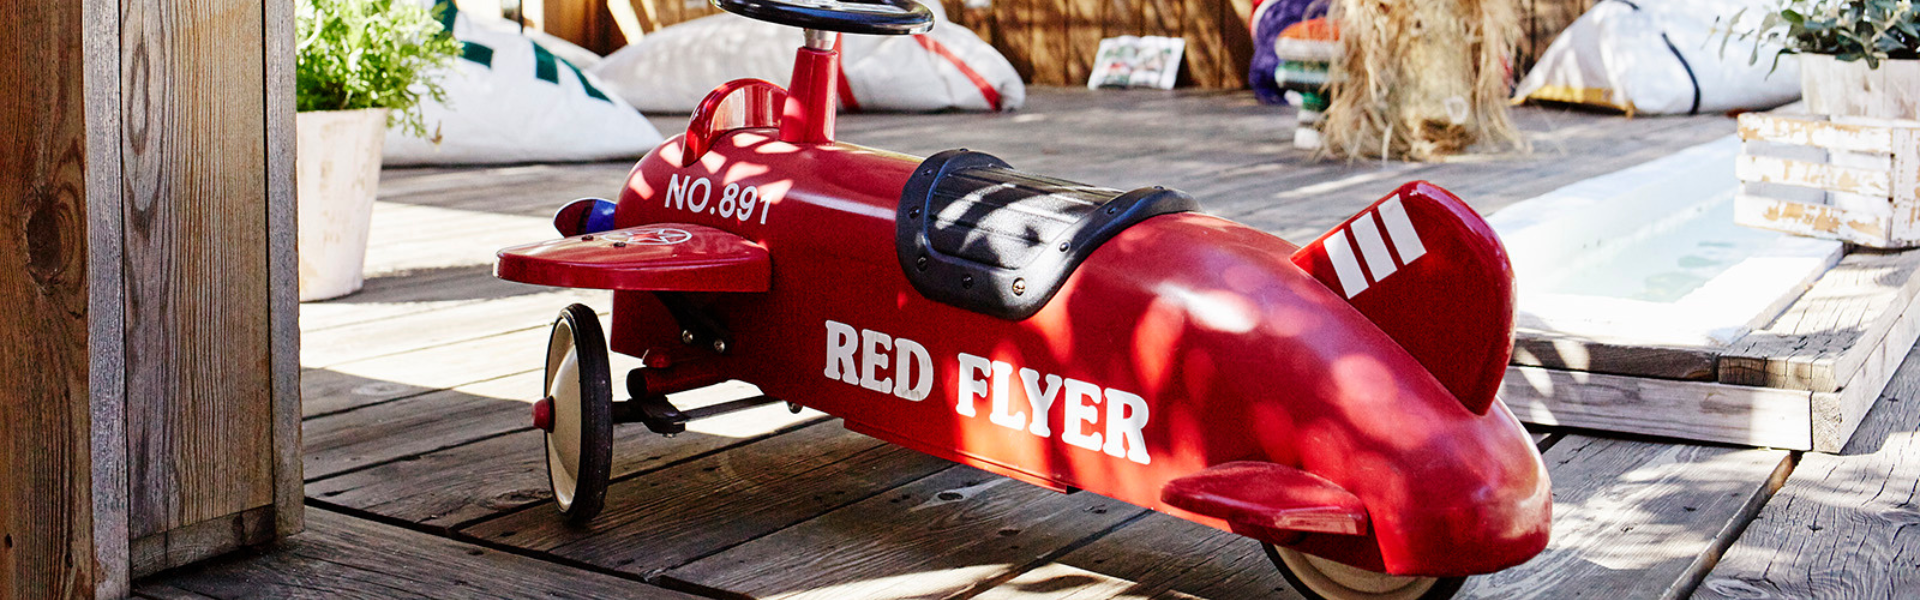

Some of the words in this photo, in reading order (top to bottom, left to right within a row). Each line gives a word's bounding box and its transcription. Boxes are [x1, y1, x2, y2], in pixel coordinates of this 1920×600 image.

[665, 173, 772, 225] NO.891
[824, 319, 934, 402] RED
[956, 352, 1151, 465] FLYER
